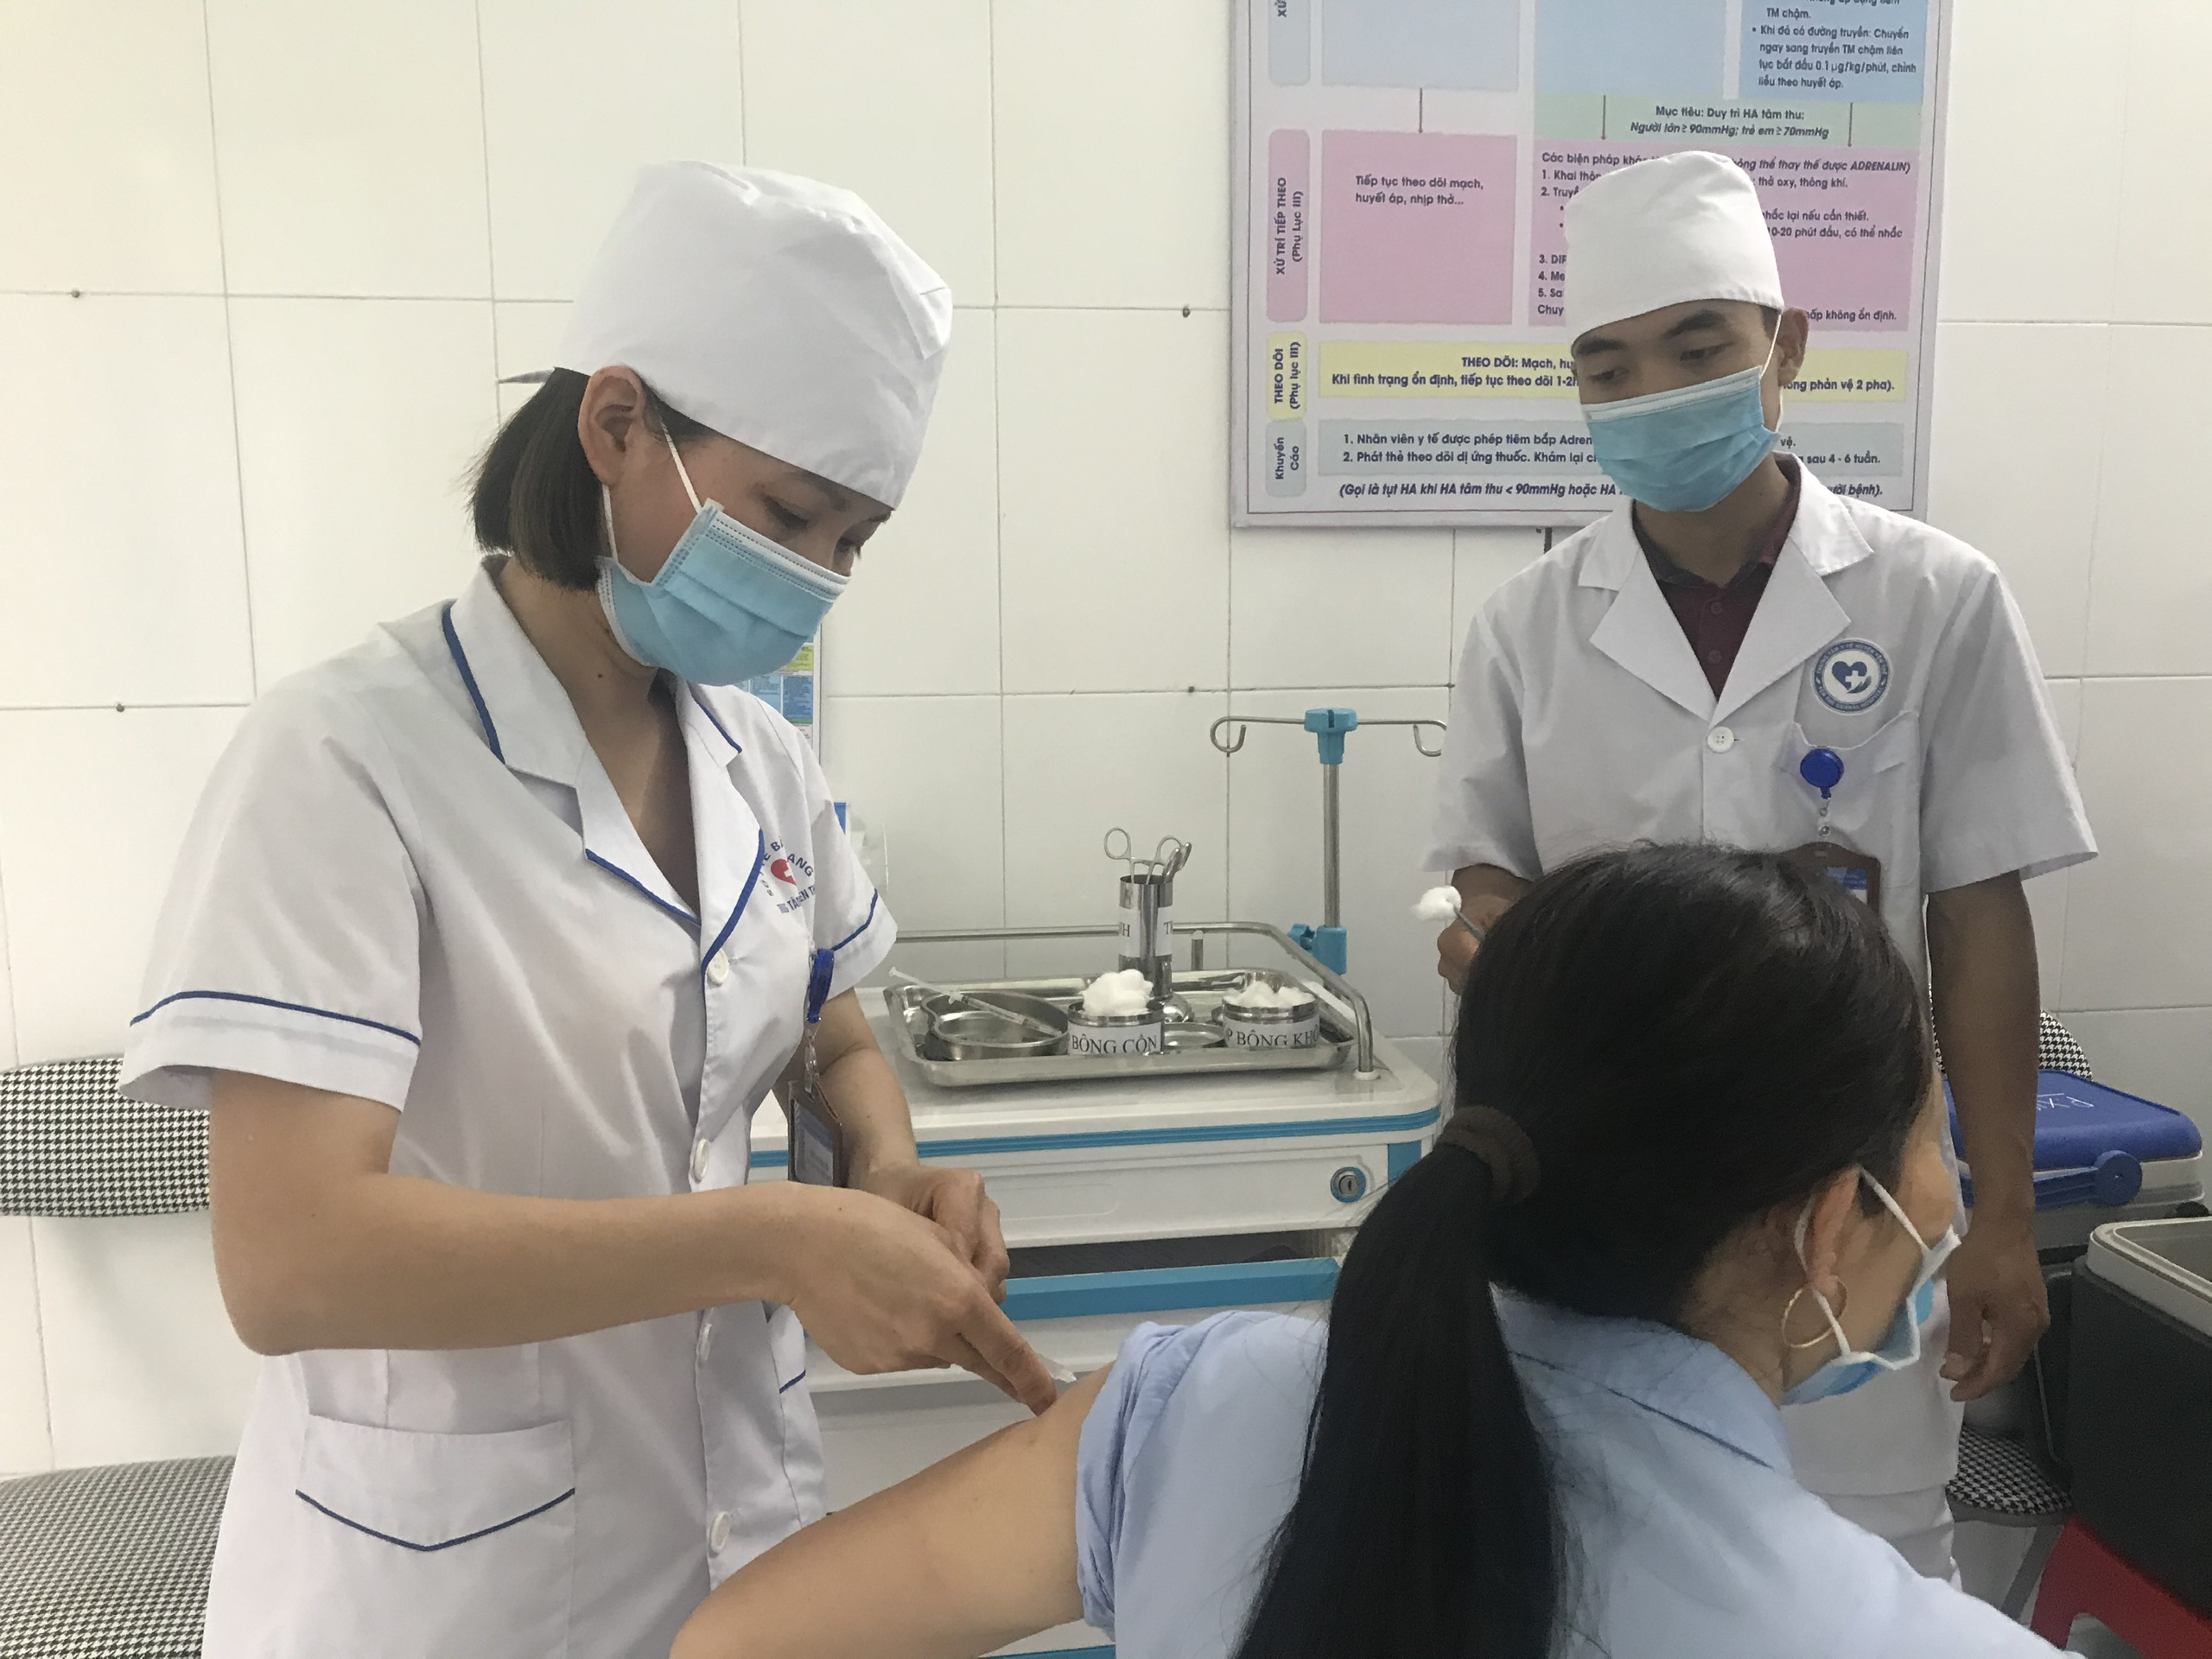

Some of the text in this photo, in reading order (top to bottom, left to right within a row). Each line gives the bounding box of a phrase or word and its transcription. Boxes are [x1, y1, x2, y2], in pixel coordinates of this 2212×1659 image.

[1766, 8, 1779, 18] TM
[1760, 24, 1776, 35] Khi
[1759, 43, 1783, 54] ngay
[1785, 45, 1808, 55] sang
[1842, 44, 1855, 54] TM
[1758, 59, 1773, 72] tục
[1815, 60, 1828, 71] 0.1
[1777, 78, 1799, 87] theo
[1656, 105, 1678, 118] Mục
[1681, 107, 1704, 118] tiêu:
[1707, 108, 1727, 120] Duy
[1744, 109, 1758, 118] HA
[1761, 108, 1782, 119] tâm
[1784, 110, 1804, 119] thu:
[1758, 127, 1774, 136] em
[1783, 126, 1829, 140] 70mmHg
[1541, 152, 1563, 162] Các
[1567, 153, 1589, 166] biện
[1592, 154, 1620, 166] pháp
[1777, 159, 1800, 170] thay
[1849, 161, 1911, 175] ADRENALIN)
[1356, 174, 1378, 188] Tiếp
[1381, 176, 1399, 189] tục
[1402, 176, 1427, 188] theo
[1541, 169, 1577, 181] 1. Khai
[1777, 179, 1797, 188] oxy,
[1800, 177, 1828, 190] thông
[1277, 177, 1287, 209] THEO
[1541, 187, 1550, 197] 2.
[1355, 191, 1386, 205] huyết
[1410, 194, 1433, 207] nhịp
[1788, 210, 1800, 223] lại
[1539, 254, 1548, 264] 3.
[1538, 270, 1548, 281] 4.
[1537, 288, 1548, 298] 5.
[1826, 310, 1856, 323] không
[1461, 357, 1491, 367] THEO
[1521, 358, 1556, 371] Mạch,
[1332, 373, 1351, 385] Khi
[1353, 373, 1375, 385] tình
[1377, 373, 1408, 388] trạng
[1429, 374, 1458, 388] định,
[1460, 372, 1483, 387] tiếp
[1485, 374, 1503, 388] tục
[1506, 375, 1532, 386] theo
[1856, 379, 1864, 390] 2
[1866, 379, 1895, 392] pha).
[1274, 373, 1284, 404] THEO
[1344, 434, 1354, 444] 1.
[1357, 433, 1388, 444] Nhân
[1390, 433, 1414, 444] viên
[1418, 435, 1425, 447] y
[1427, 431, 1440, 444] tế
[1441, 434, 1471, 447] được
[1473, 433, 1503, 446] phép
[1505, 434, 1530, 445] tiêm
[1289, 445, 1300, 471] Cáo
[1343, 451, 1353, 462] 2.
[1357, 450, 1383, 462] Phát
[1386, 449, 1404, 462] thẻ
[1407, 451, 1433, 462] theo
[1456, 451, 1468, 465] dị
[1471, 449, 1493, 465] ứng
[1495, 448, 1530, 462] thuốc.
[1534, 451, 1567, 463] Khám
[1569, 451, 1584, 465] lại
[1807, 454, 1827, 464] sau
[1828, 454, 1836, 463] 4
[1844, 454, 1852, 463] 6
[1339, 483, 1366, 499] (Gọi
[1368, 482, 1380, 495] là
[1382, 483, 1398, 498] tụt
[1400, 483, 1417, 495] HA
[1420, 483, 1439, 495] khi
[1440, 483, 1457, 495] HA
[1459, 482, 1482, 495] tâm
[1484, 483, 1503, 495] thu
[1516, 483, 1566, 498] 90mmHg
[1567, 483, 1598, 499] hoặc
[1599, 484, 1617, 495] HA
[1071, 1033, 1117, 1054] BÔNG
[1236, 1029, 1287, 1047] BÔNG
